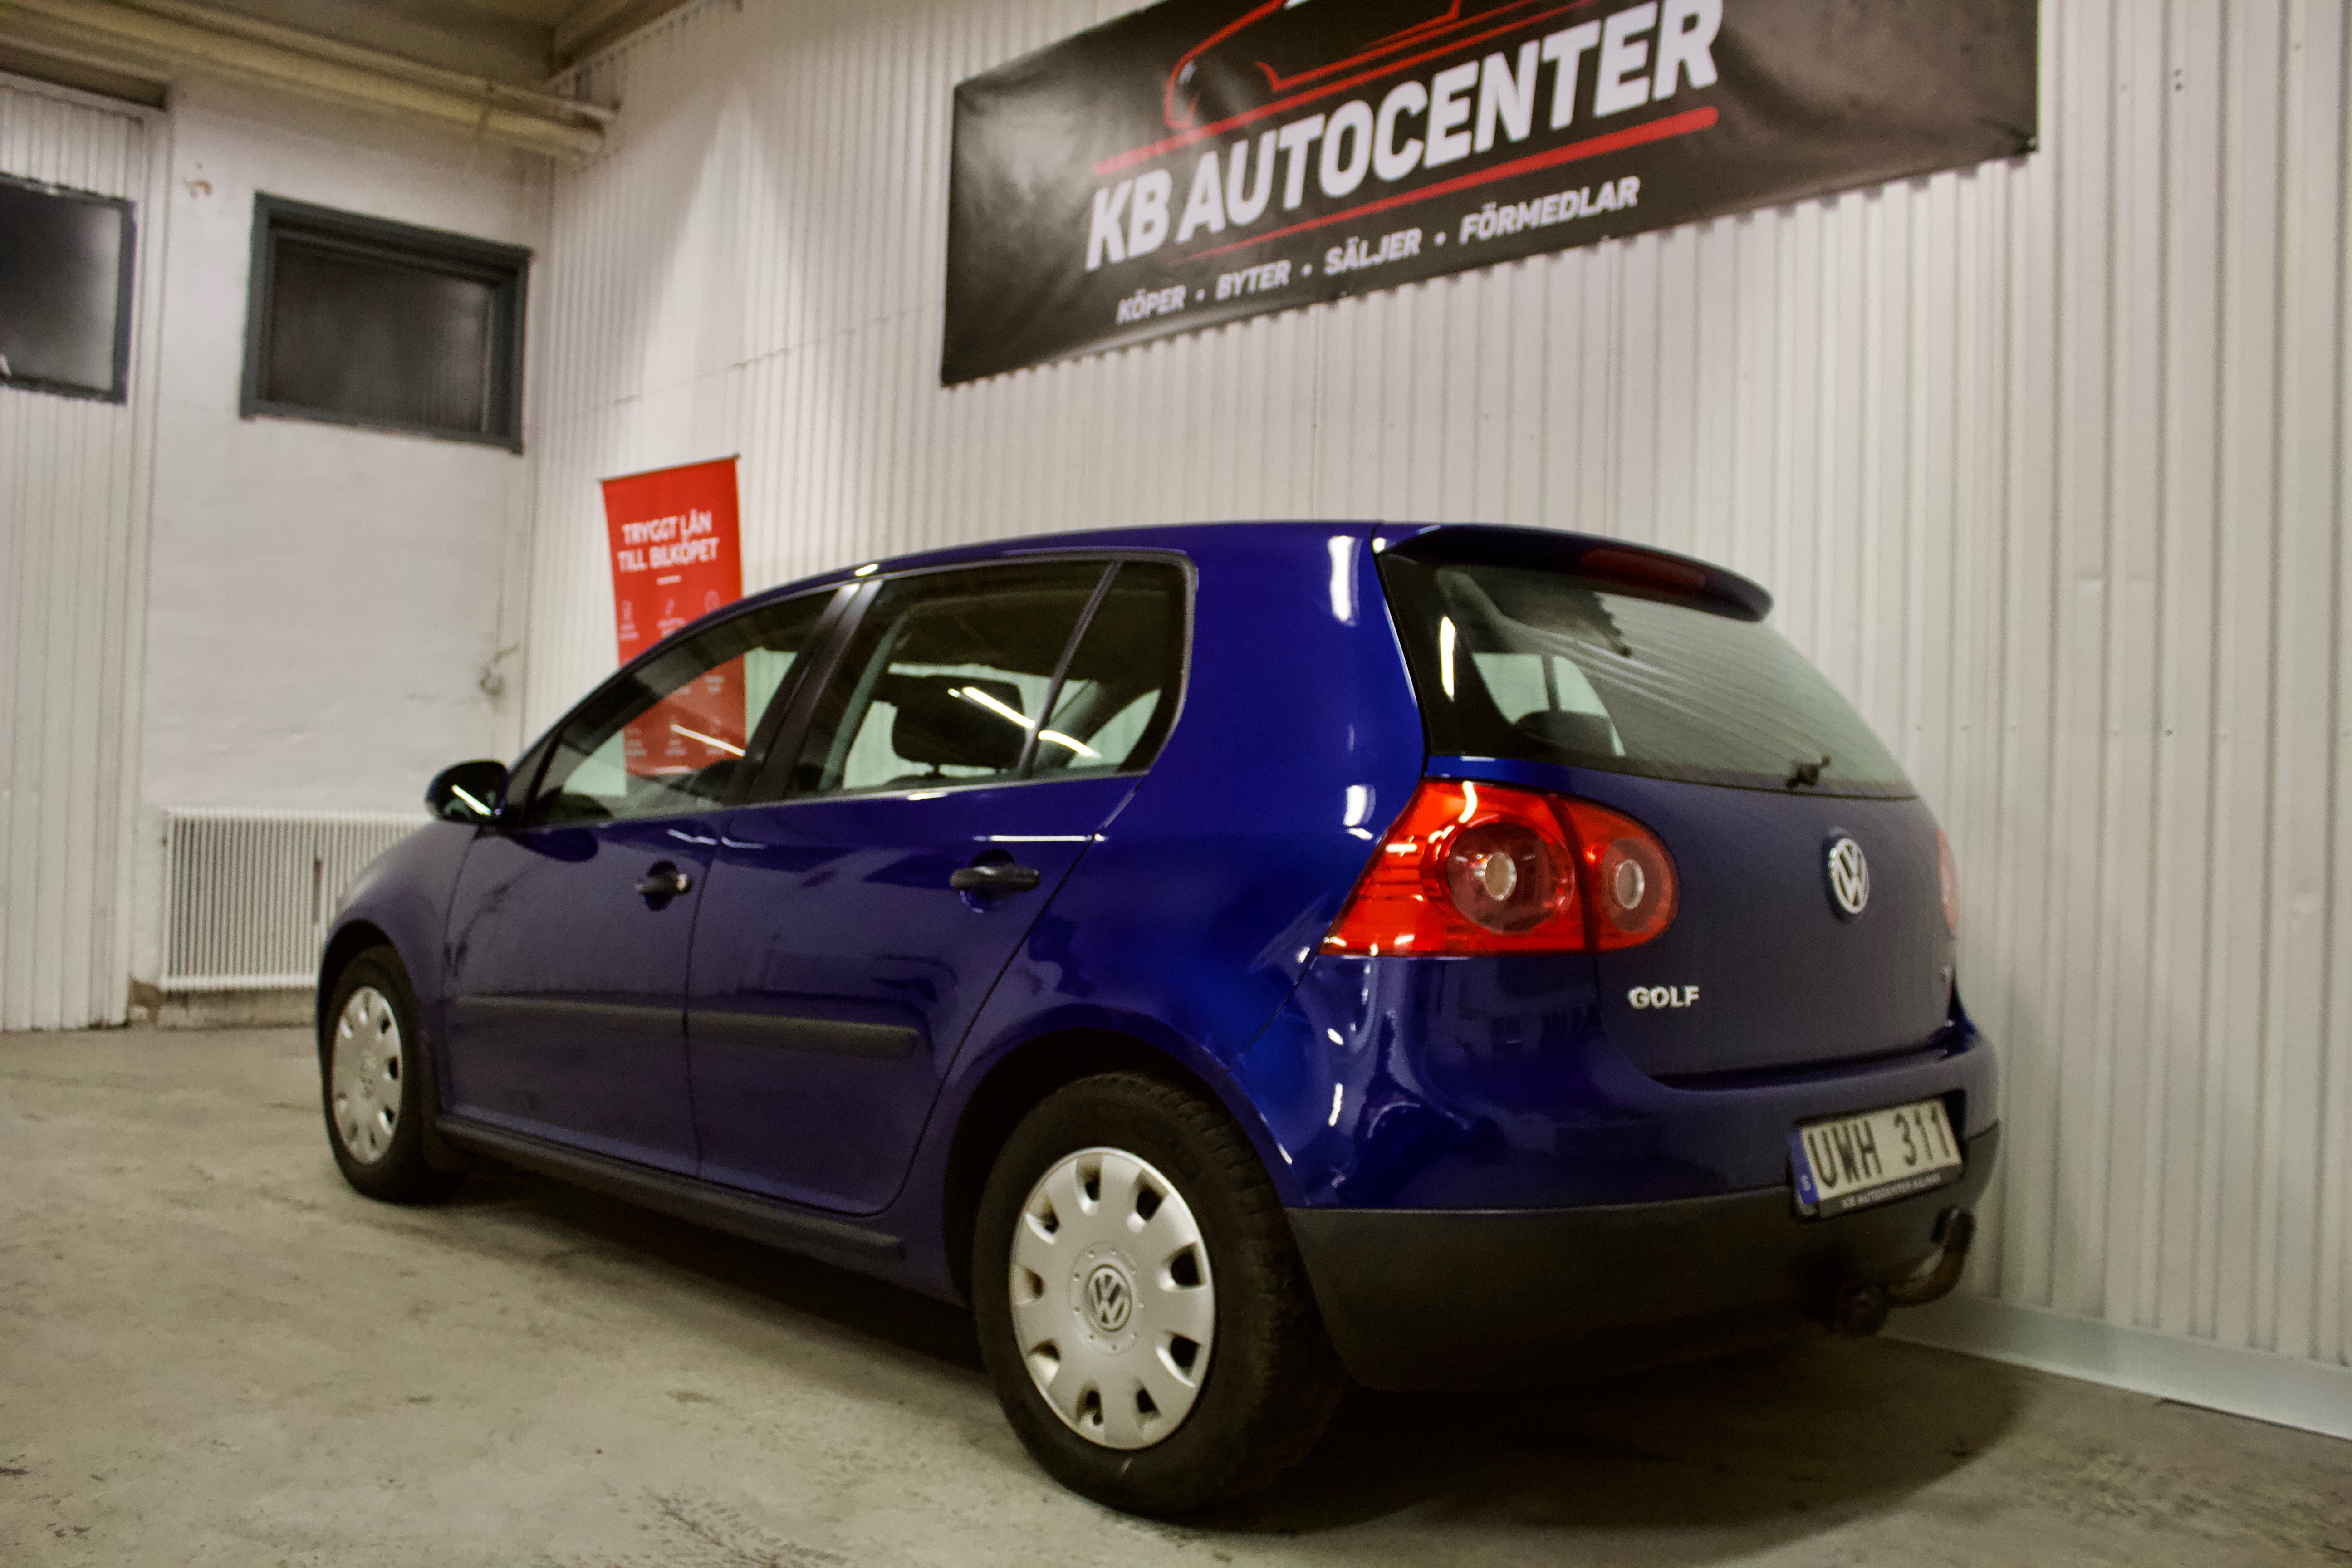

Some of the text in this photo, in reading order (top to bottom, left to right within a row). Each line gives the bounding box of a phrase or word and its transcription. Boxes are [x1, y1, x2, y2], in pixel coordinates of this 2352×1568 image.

[1086, 0, 1723, 272] KB AUTOCENTER
[1116, 176, 1641, 324] KÖPER BYTER SÄLJER FÖRMEDLAR
[617, 548, 648, 572] TILL
[1628, 985, 1700, 1009] GOLF
[1893, 1106, 1950, 1166] 311
